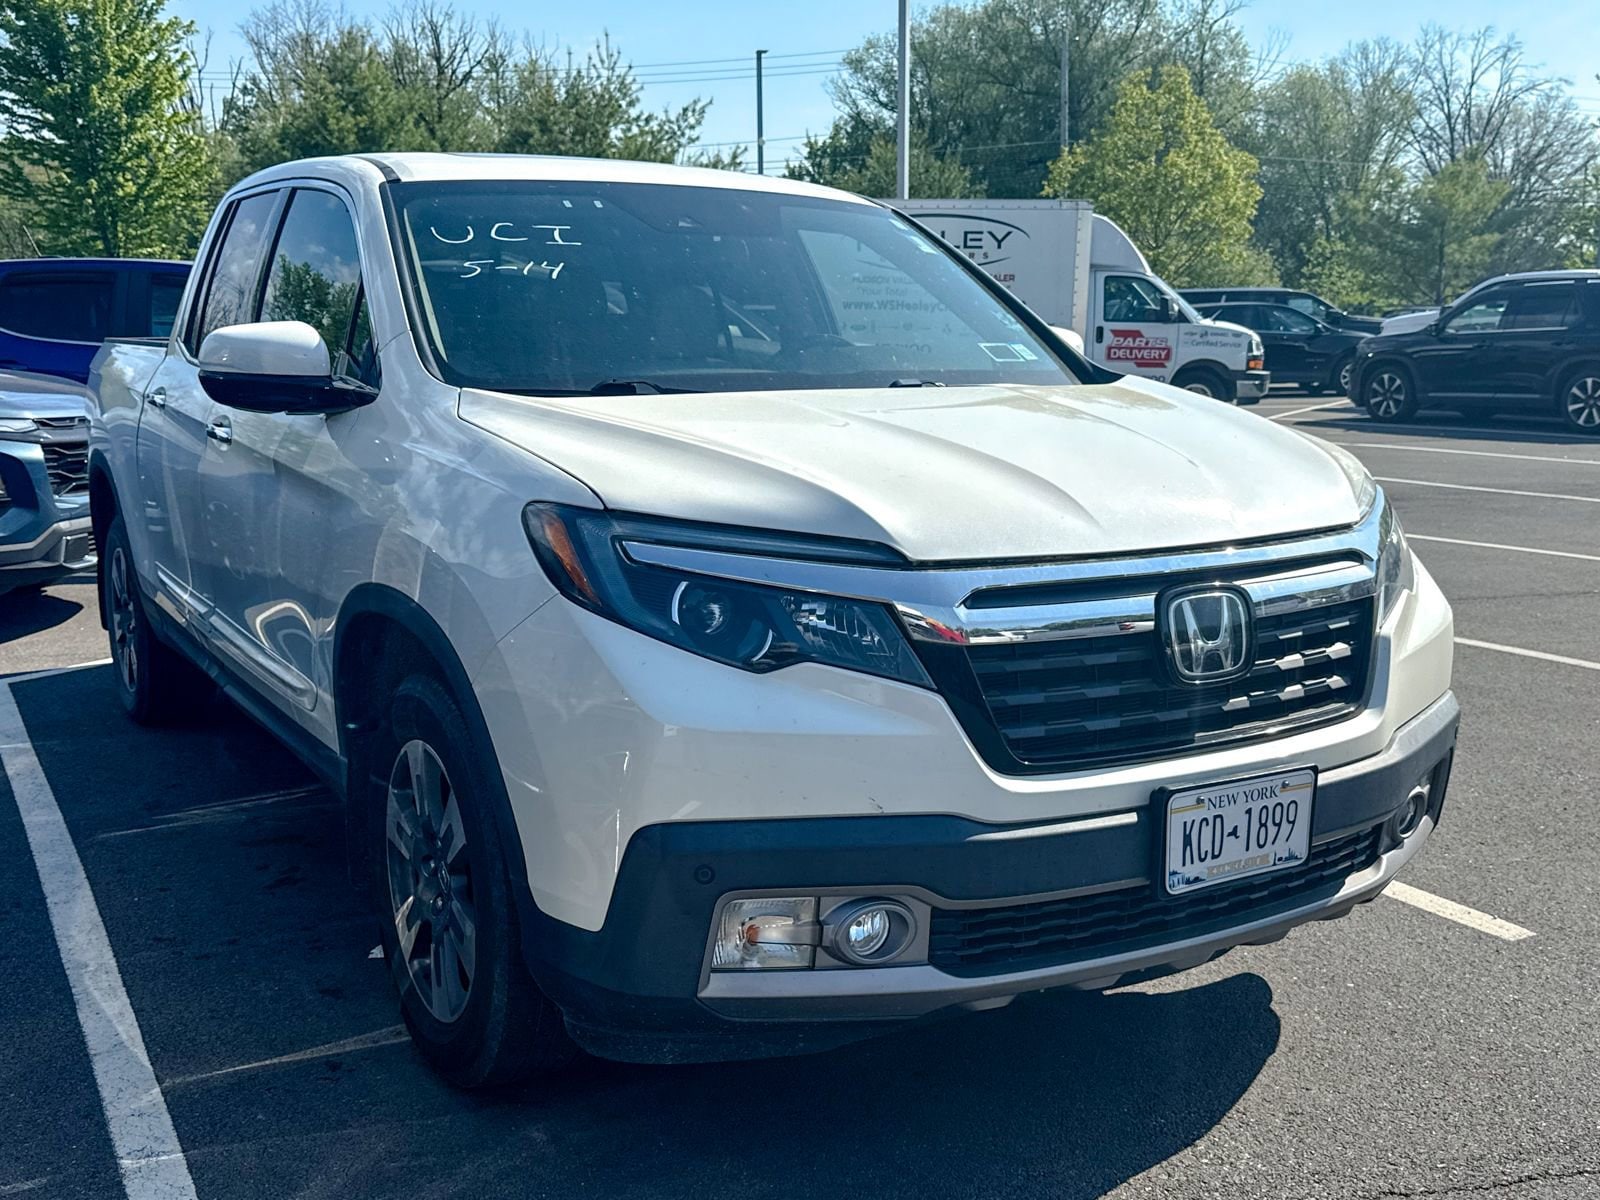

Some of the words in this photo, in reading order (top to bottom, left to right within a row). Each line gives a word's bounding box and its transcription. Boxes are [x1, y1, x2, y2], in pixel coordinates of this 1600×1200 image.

[430, 222, 582, 245] UCI
[460, 259, 565, 279] 5-14
[1111, 337, 1168, 347] PARTS
[1110, 349, 1169, 360] DELIVERY
[1207, 792, 1240, 811] NEW
[1243, 785, 1280, 803] YORK
[1181, 813, 1225, 867] KCD
[1244, 800, 1299, 852] 1899
